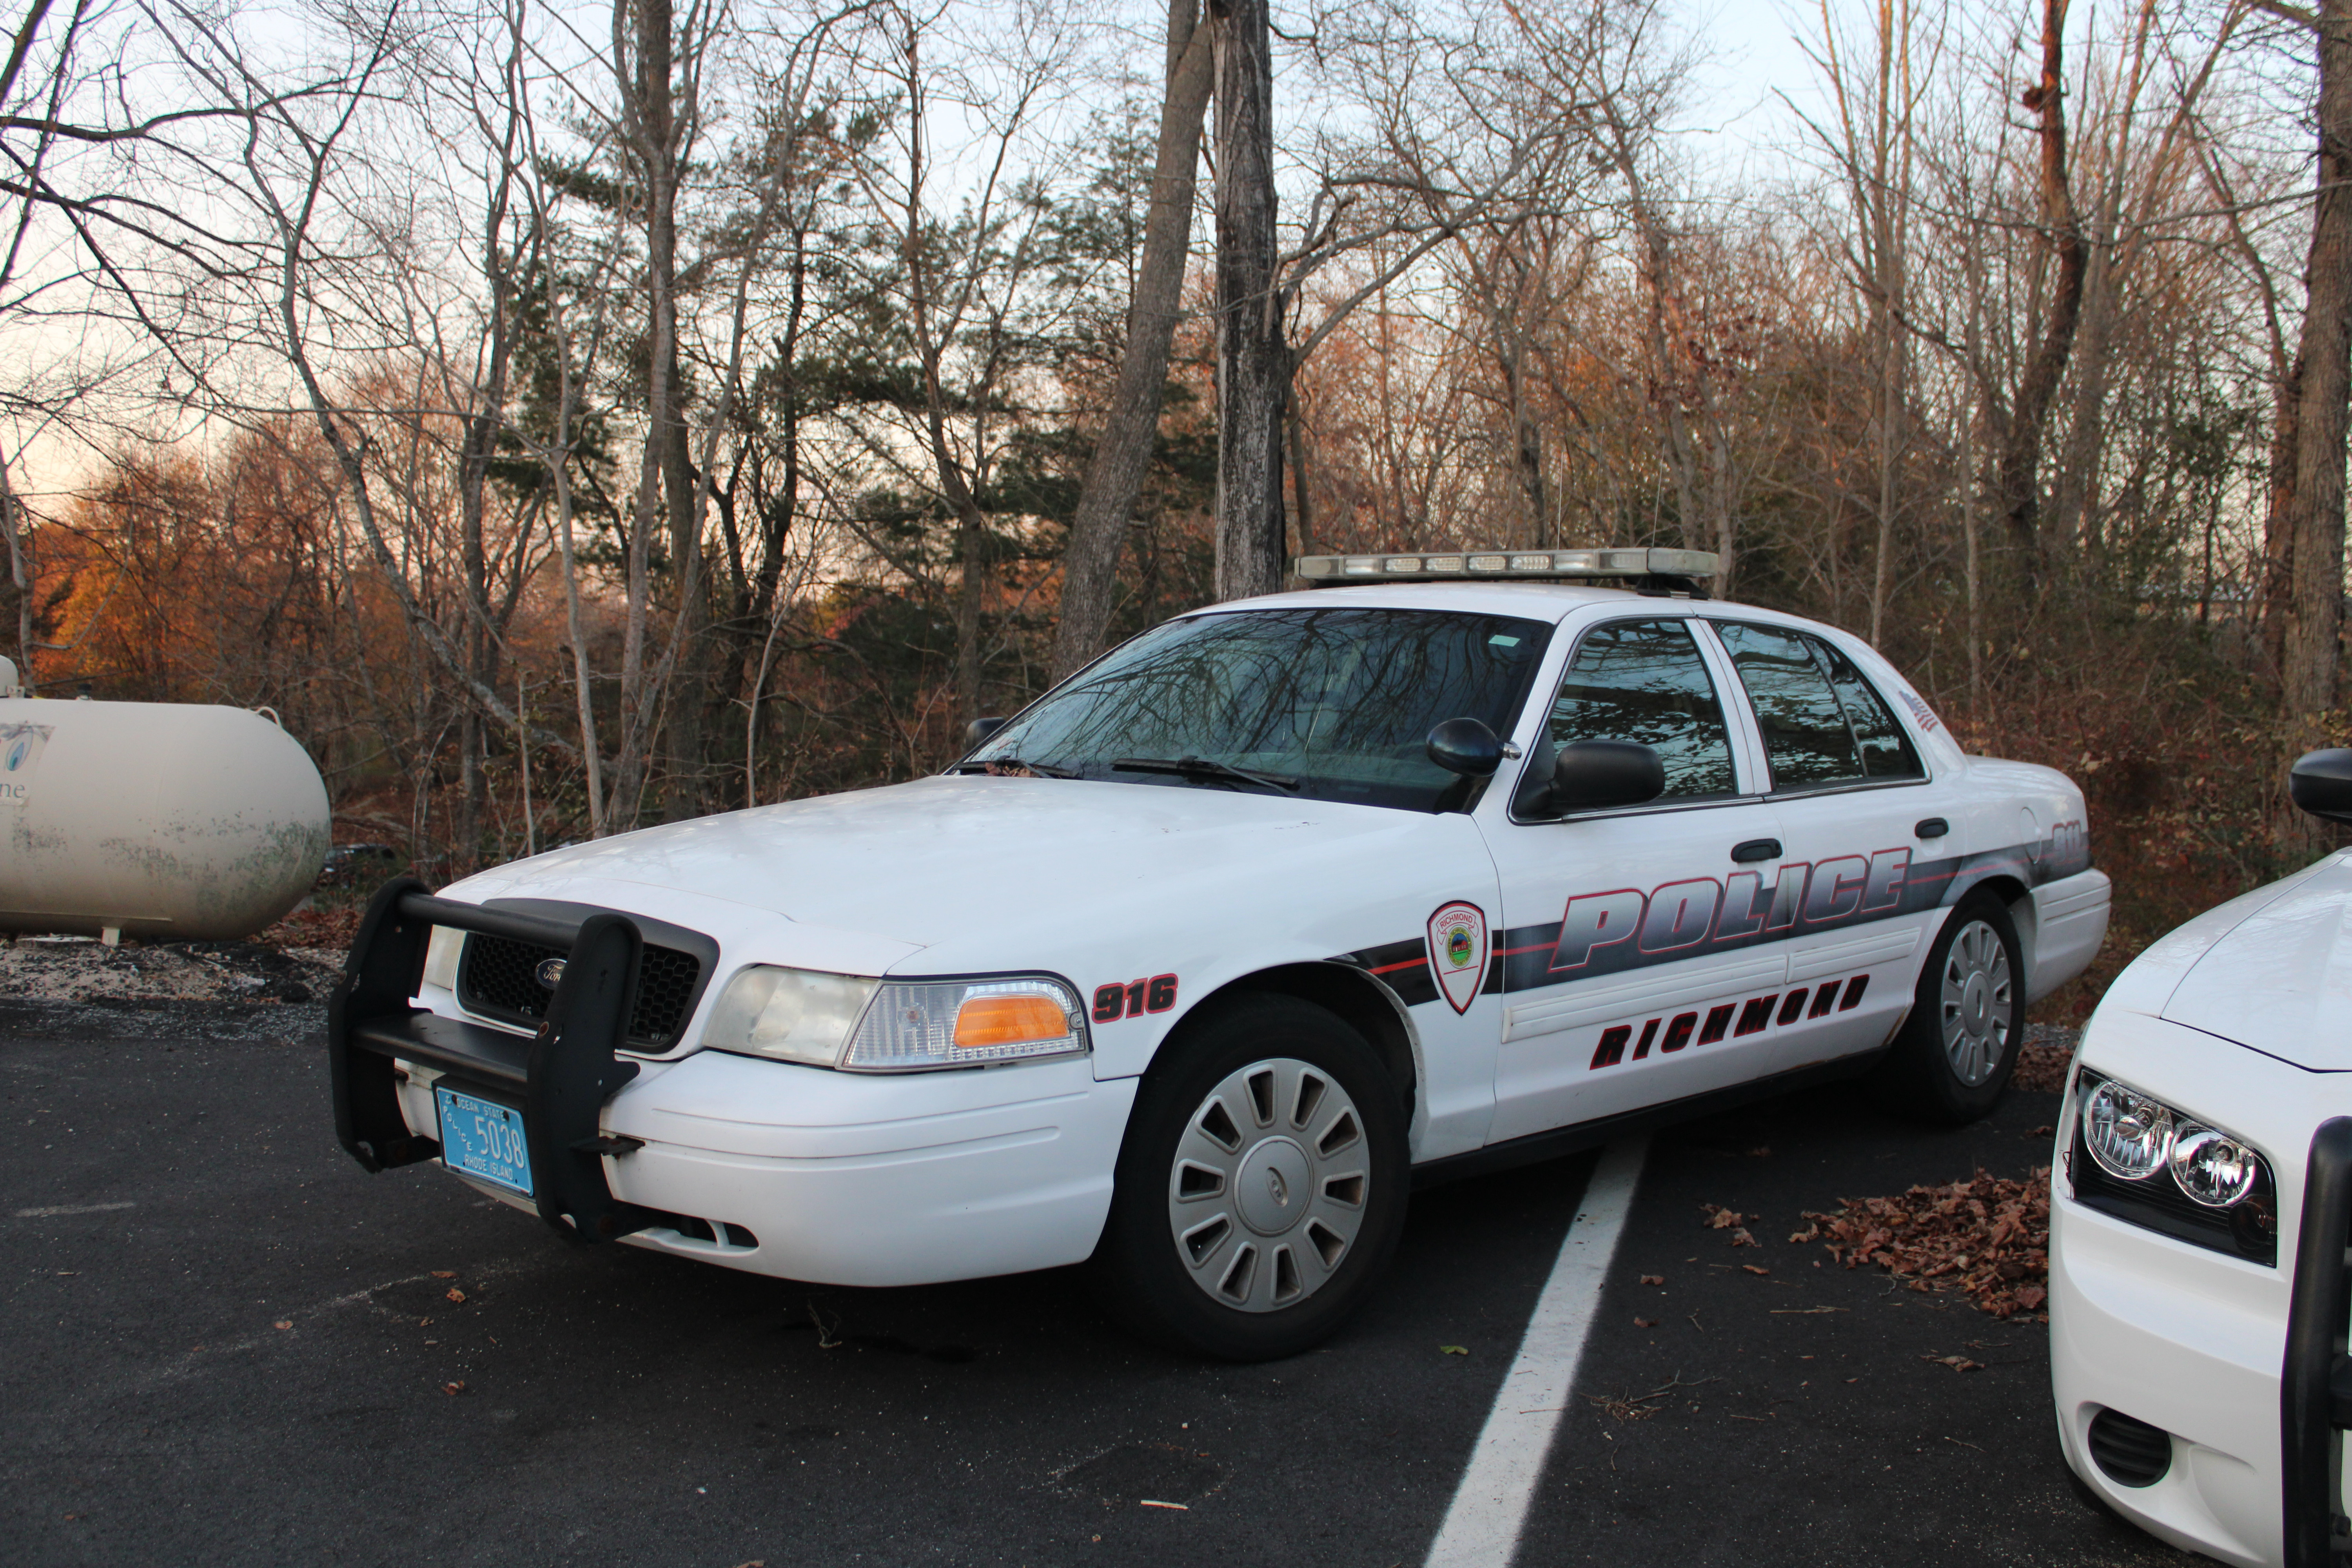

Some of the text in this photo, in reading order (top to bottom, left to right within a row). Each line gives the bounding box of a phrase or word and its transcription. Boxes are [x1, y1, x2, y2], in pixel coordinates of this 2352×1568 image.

[1440, 913, 1473, 929] RICHMOND
[1546, 846, 1913, 973] POLICE
[1092, 973, 1178, 1024] 916
[1590, 974, 1870, 1070] RICHMOND
[443, 1105, 473, 1152] POLICE
[457, 1098, 506, 1122] OCEAN STATE
[474, 1115, 524, 1169] 5038
[464, 1154, 514, 1181] RHODE ISLAND
